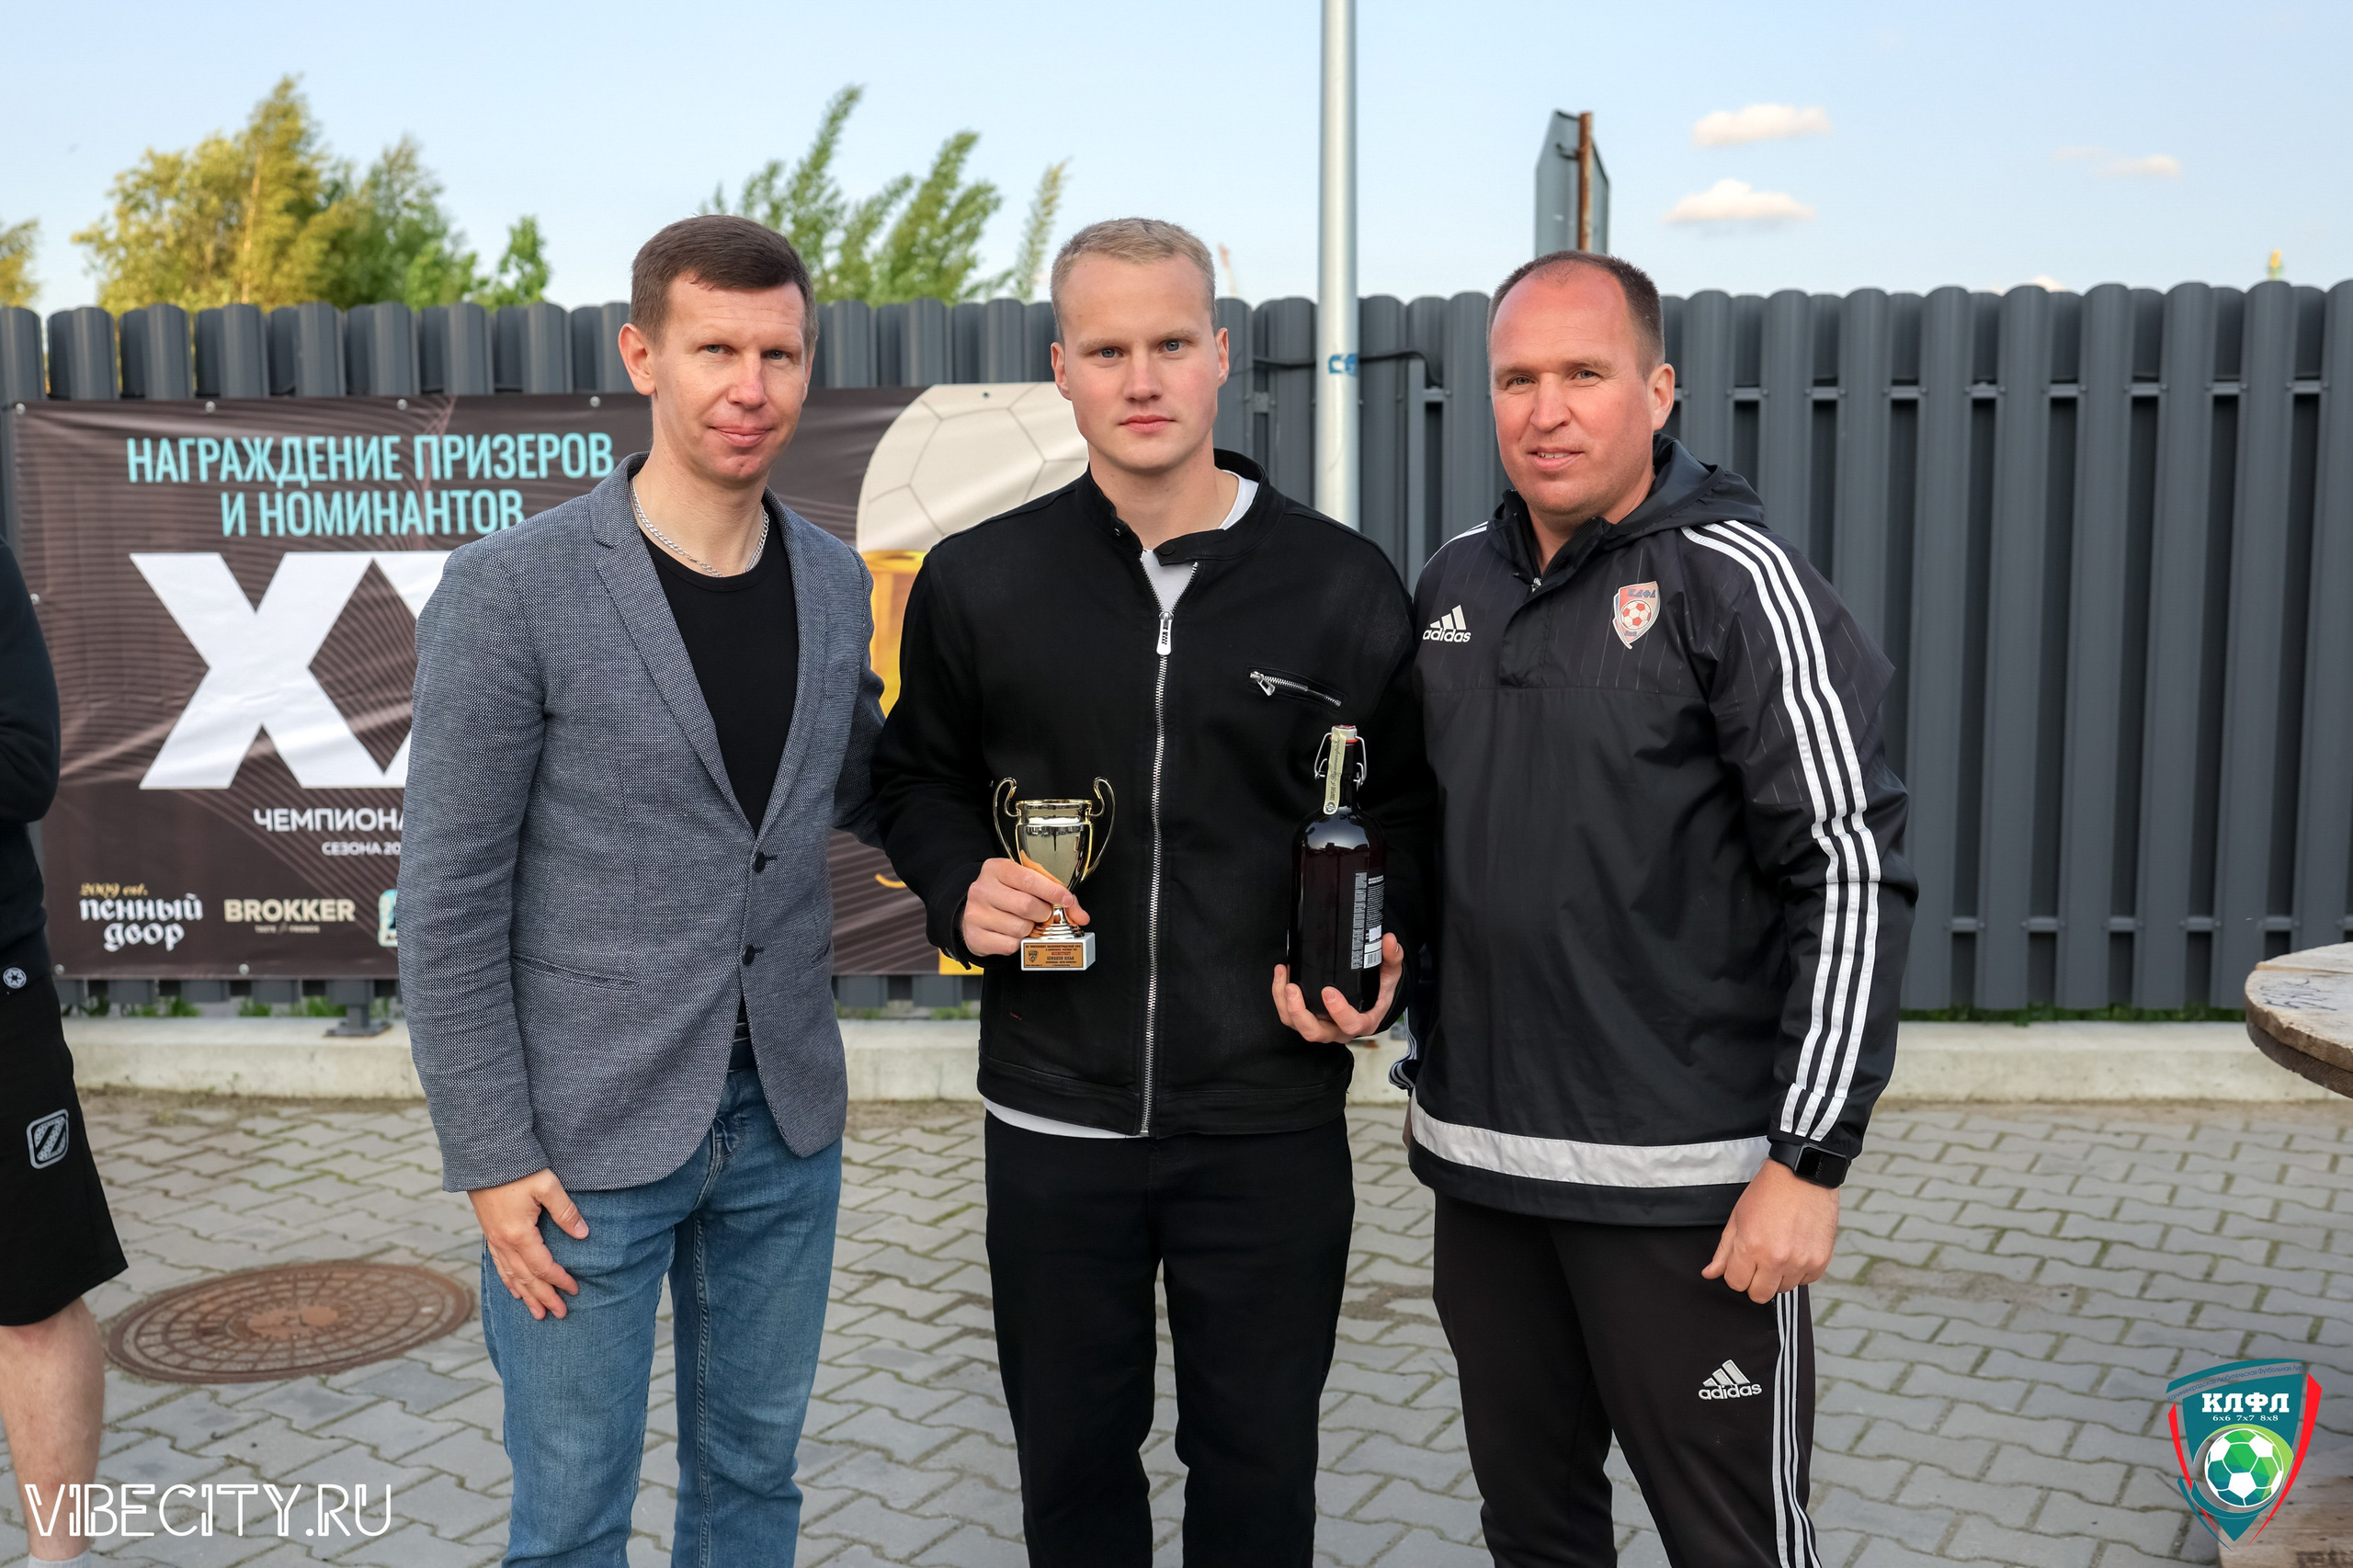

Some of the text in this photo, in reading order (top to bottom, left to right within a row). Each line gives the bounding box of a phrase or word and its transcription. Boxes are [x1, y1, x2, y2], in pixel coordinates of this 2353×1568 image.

[127, 432, 615, 489] НАГРАЖДЕНИЕ ПРИЗЕРОВ
[221, 489, 525, 537] И НОМИНАНТОВ
[1422, 627, 1472, 642] adidas
[321, 841, 382, 856] СЕЗОНА
[224, 898, 356, 923] BROKKER
[1698, 1383, 1763, 1401] adidas
